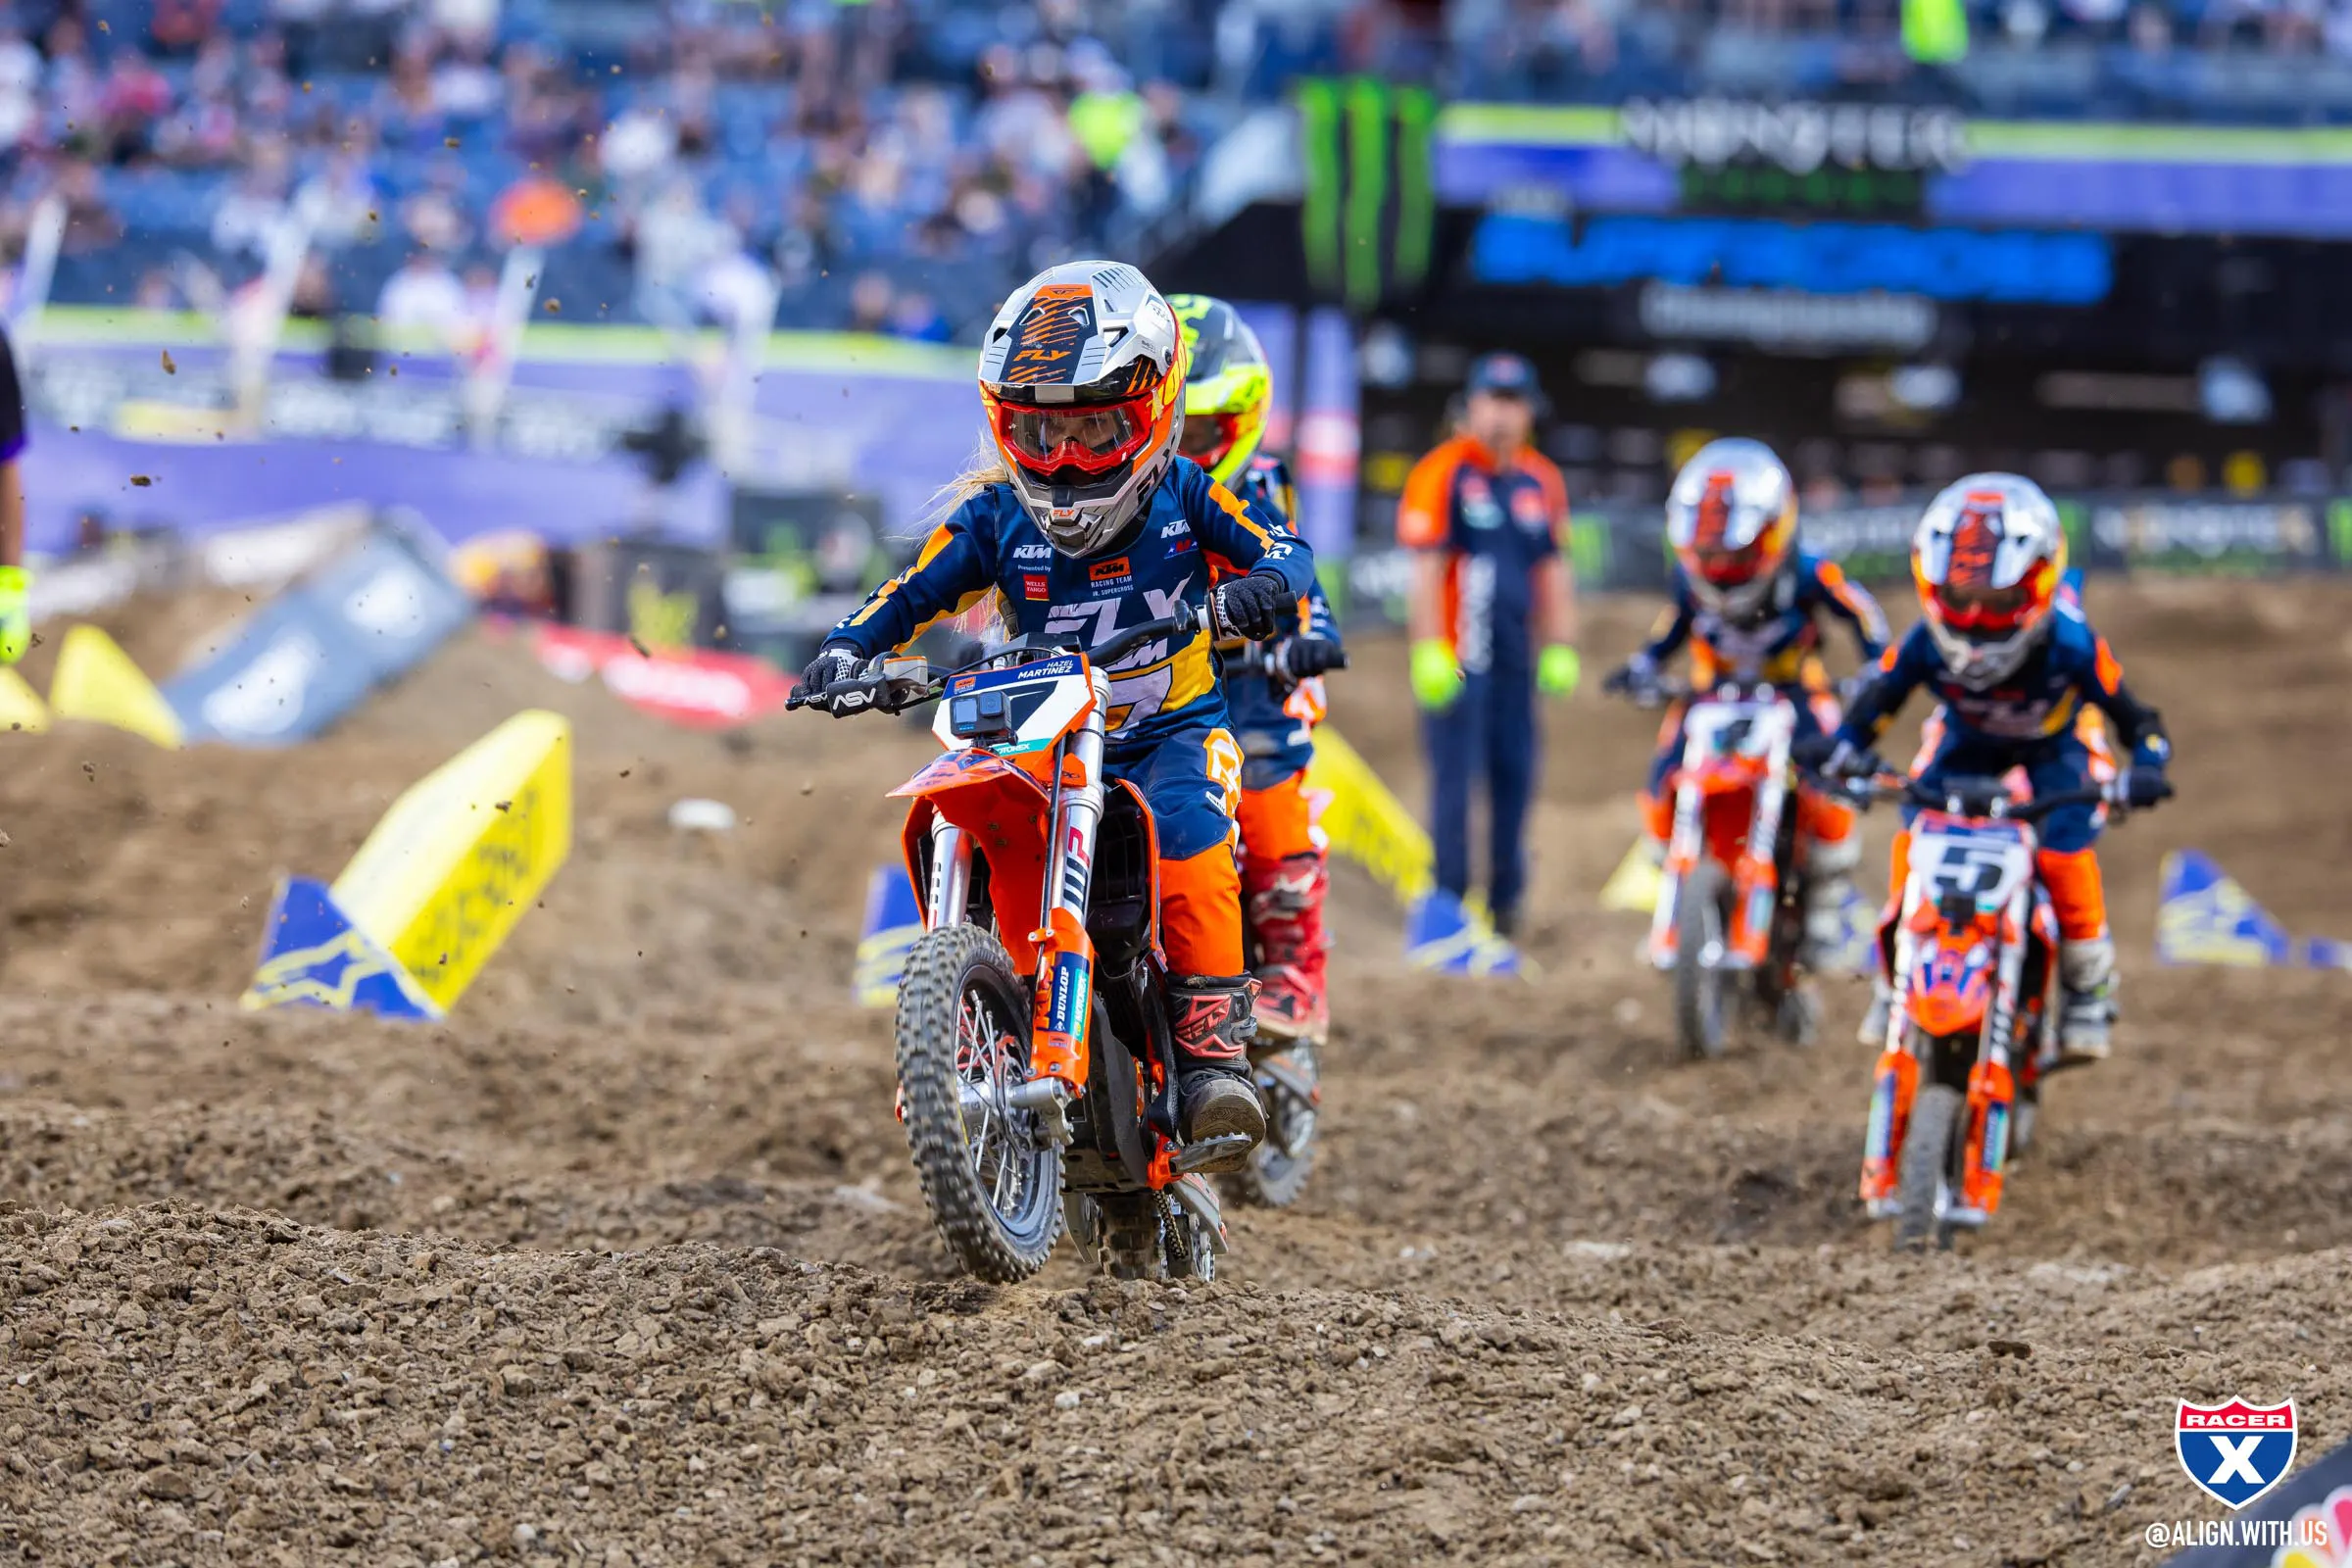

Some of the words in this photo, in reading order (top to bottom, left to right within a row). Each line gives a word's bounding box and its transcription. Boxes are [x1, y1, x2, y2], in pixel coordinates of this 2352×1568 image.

[1013, 349, 1073, 362] FLY
[1054, 509, 1075, 518] FLY
[1012, 544, 1053, 559] KTM
[1090, 578, 1114, 589] RACING
[1115, 574, 1133, 585] TEAM
[1101, 584, 1135, 596] SUPERCROSS
[1045, 570, 1194, 647] FLY
[1046, 660, 1074, 669] HAZEL
[1017, 665, 1073, 680] MARTINEZ
[832, 688, 877, 710] ASV
[997, 743, 1031, 755] OTOREX
[1934, 845, 2006, 897] 5
[1056, 965, 1069, 1022] DUNLOP
